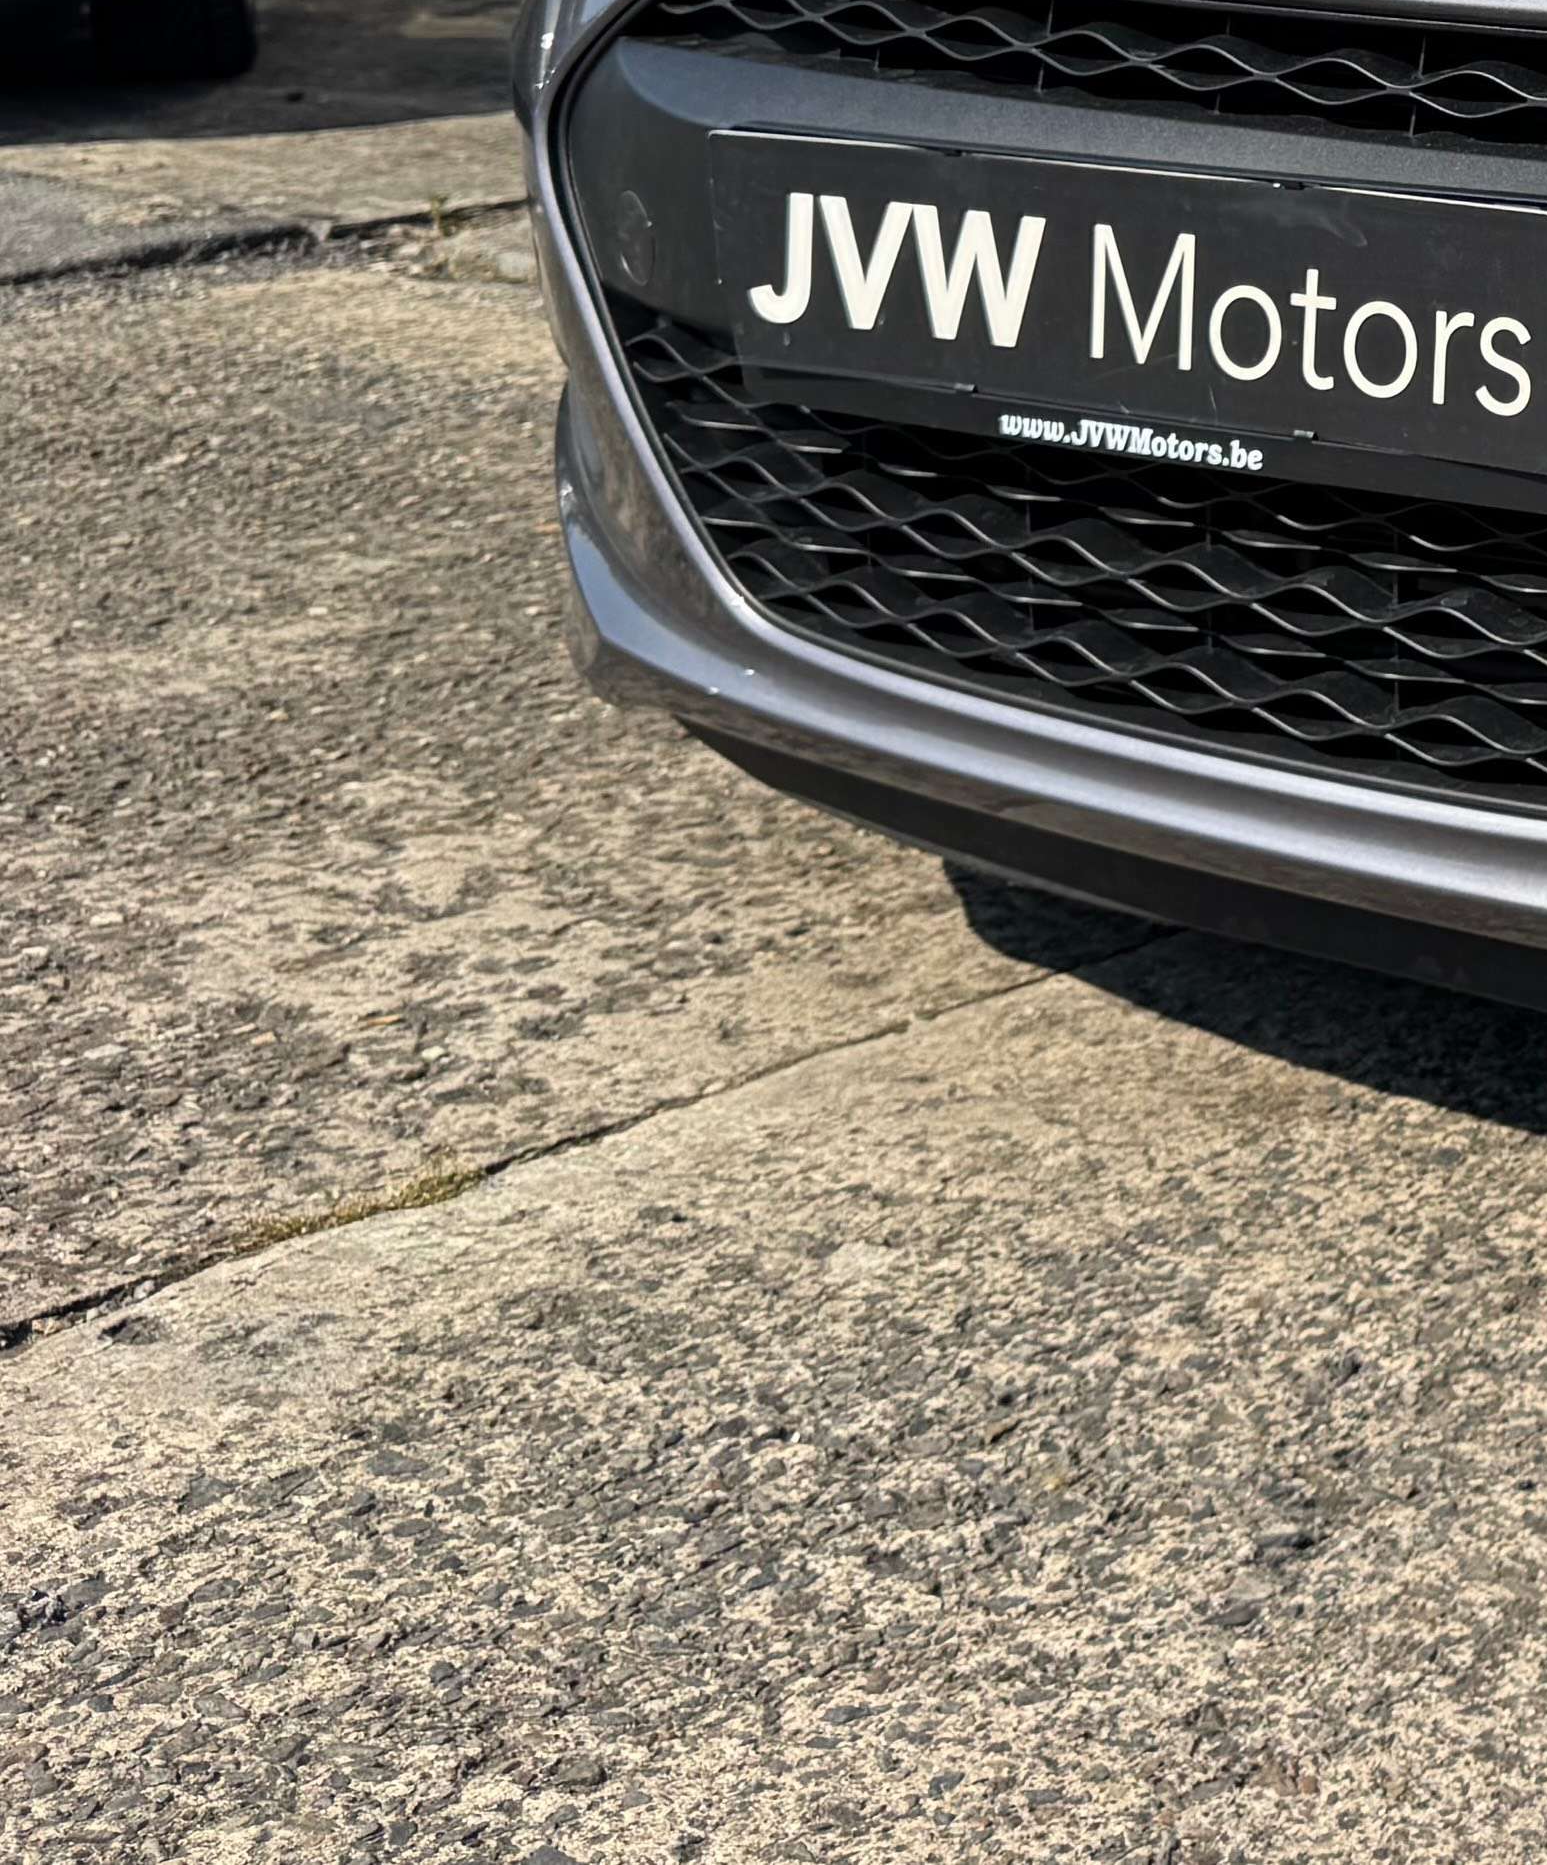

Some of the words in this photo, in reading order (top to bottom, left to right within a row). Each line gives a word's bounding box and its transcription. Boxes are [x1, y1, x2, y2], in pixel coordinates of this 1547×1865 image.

[747, 190, 1048, 349] JVW
[1089, 222, 1533, 418] Motors
[998, 413, 1265, 472] www.JVWMotors.be
